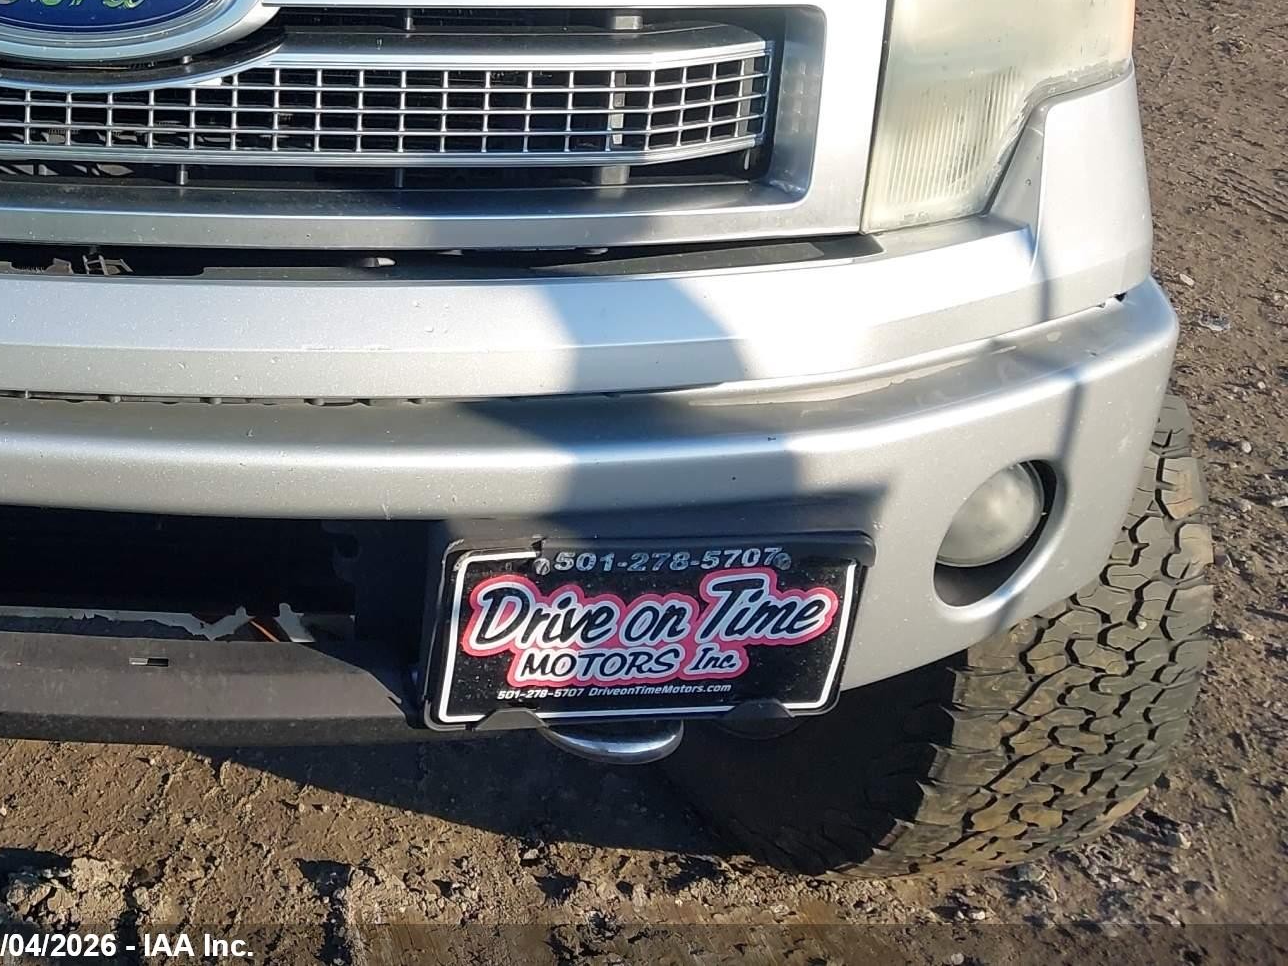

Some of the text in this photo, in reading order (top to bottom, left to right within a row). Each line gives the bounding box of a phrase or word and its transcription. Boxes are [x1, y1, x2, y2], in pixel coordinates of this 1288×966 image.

[553, 547, 782, 572] 501-278-5707
[471, 577, 831, 647] Drive on Time
[521, 647, 737, 679] MOTORS Inc.
[496, 684, 732, 701] 501-278-5707 DriveonTimeMotors.com
